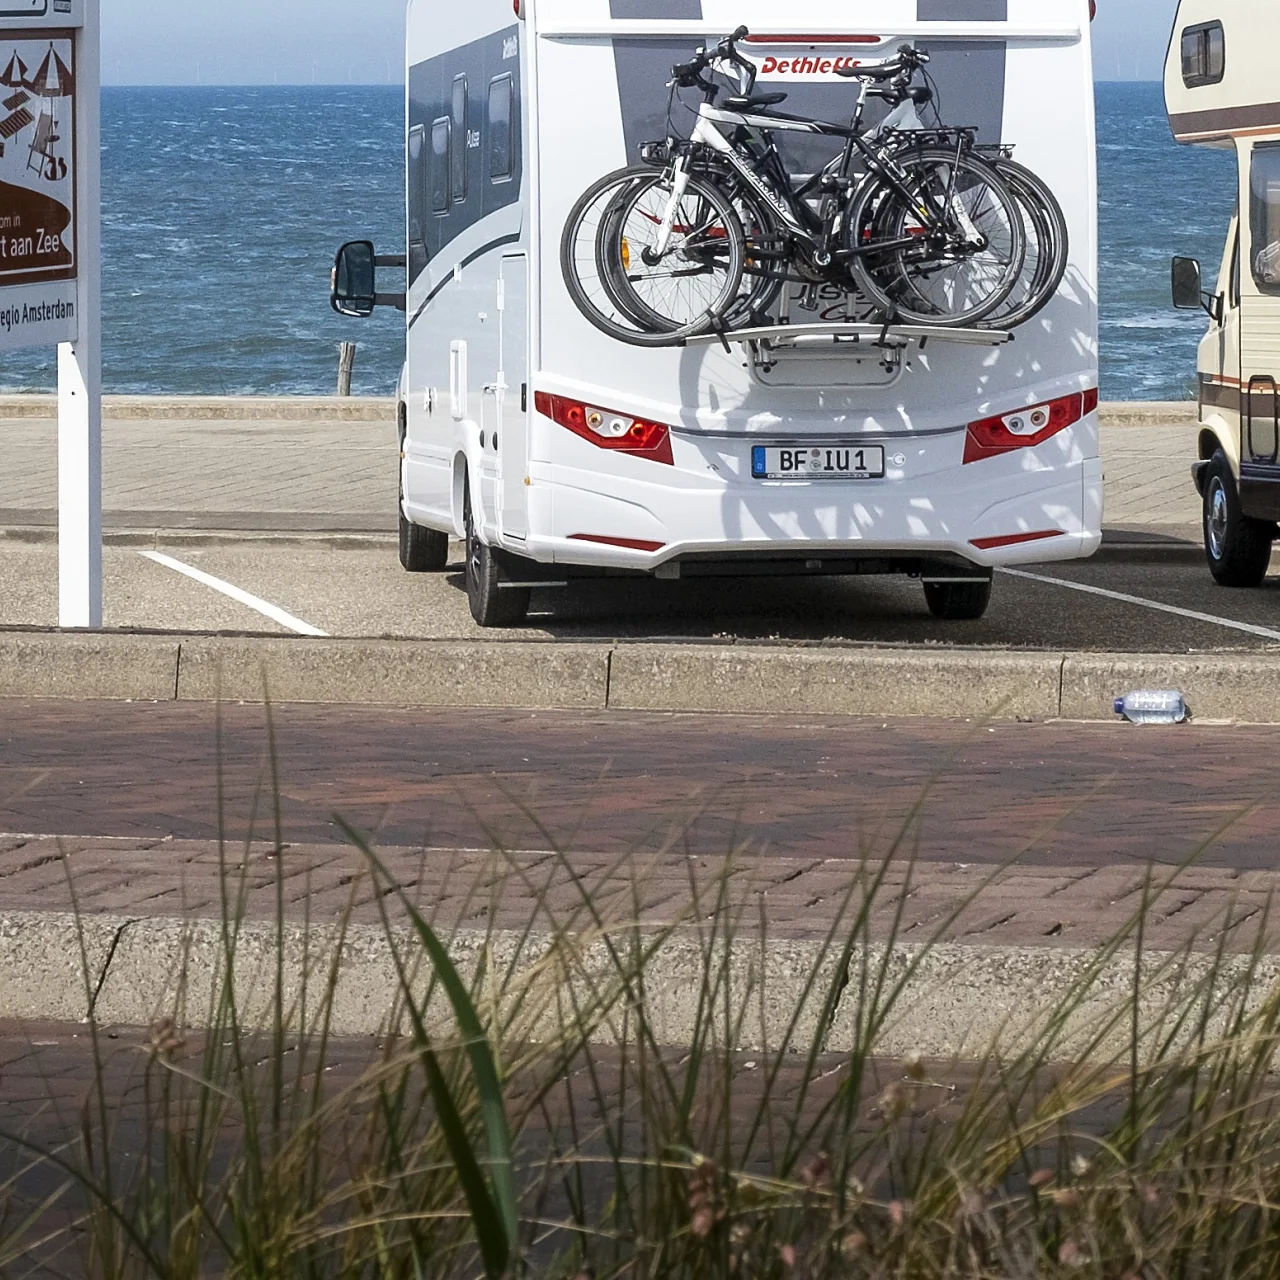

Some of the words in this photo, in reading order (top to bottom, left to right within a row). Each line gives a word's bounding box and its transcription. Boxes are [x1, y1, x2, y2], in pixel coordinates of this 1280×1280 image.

[13, 212, 21, 228] in
[10, 236, 33, 257] aan
[36, 228, 60, 254] Zee
[22, 299, 74, 323] Amsterdam
[779, 450, 808, 471] BF
